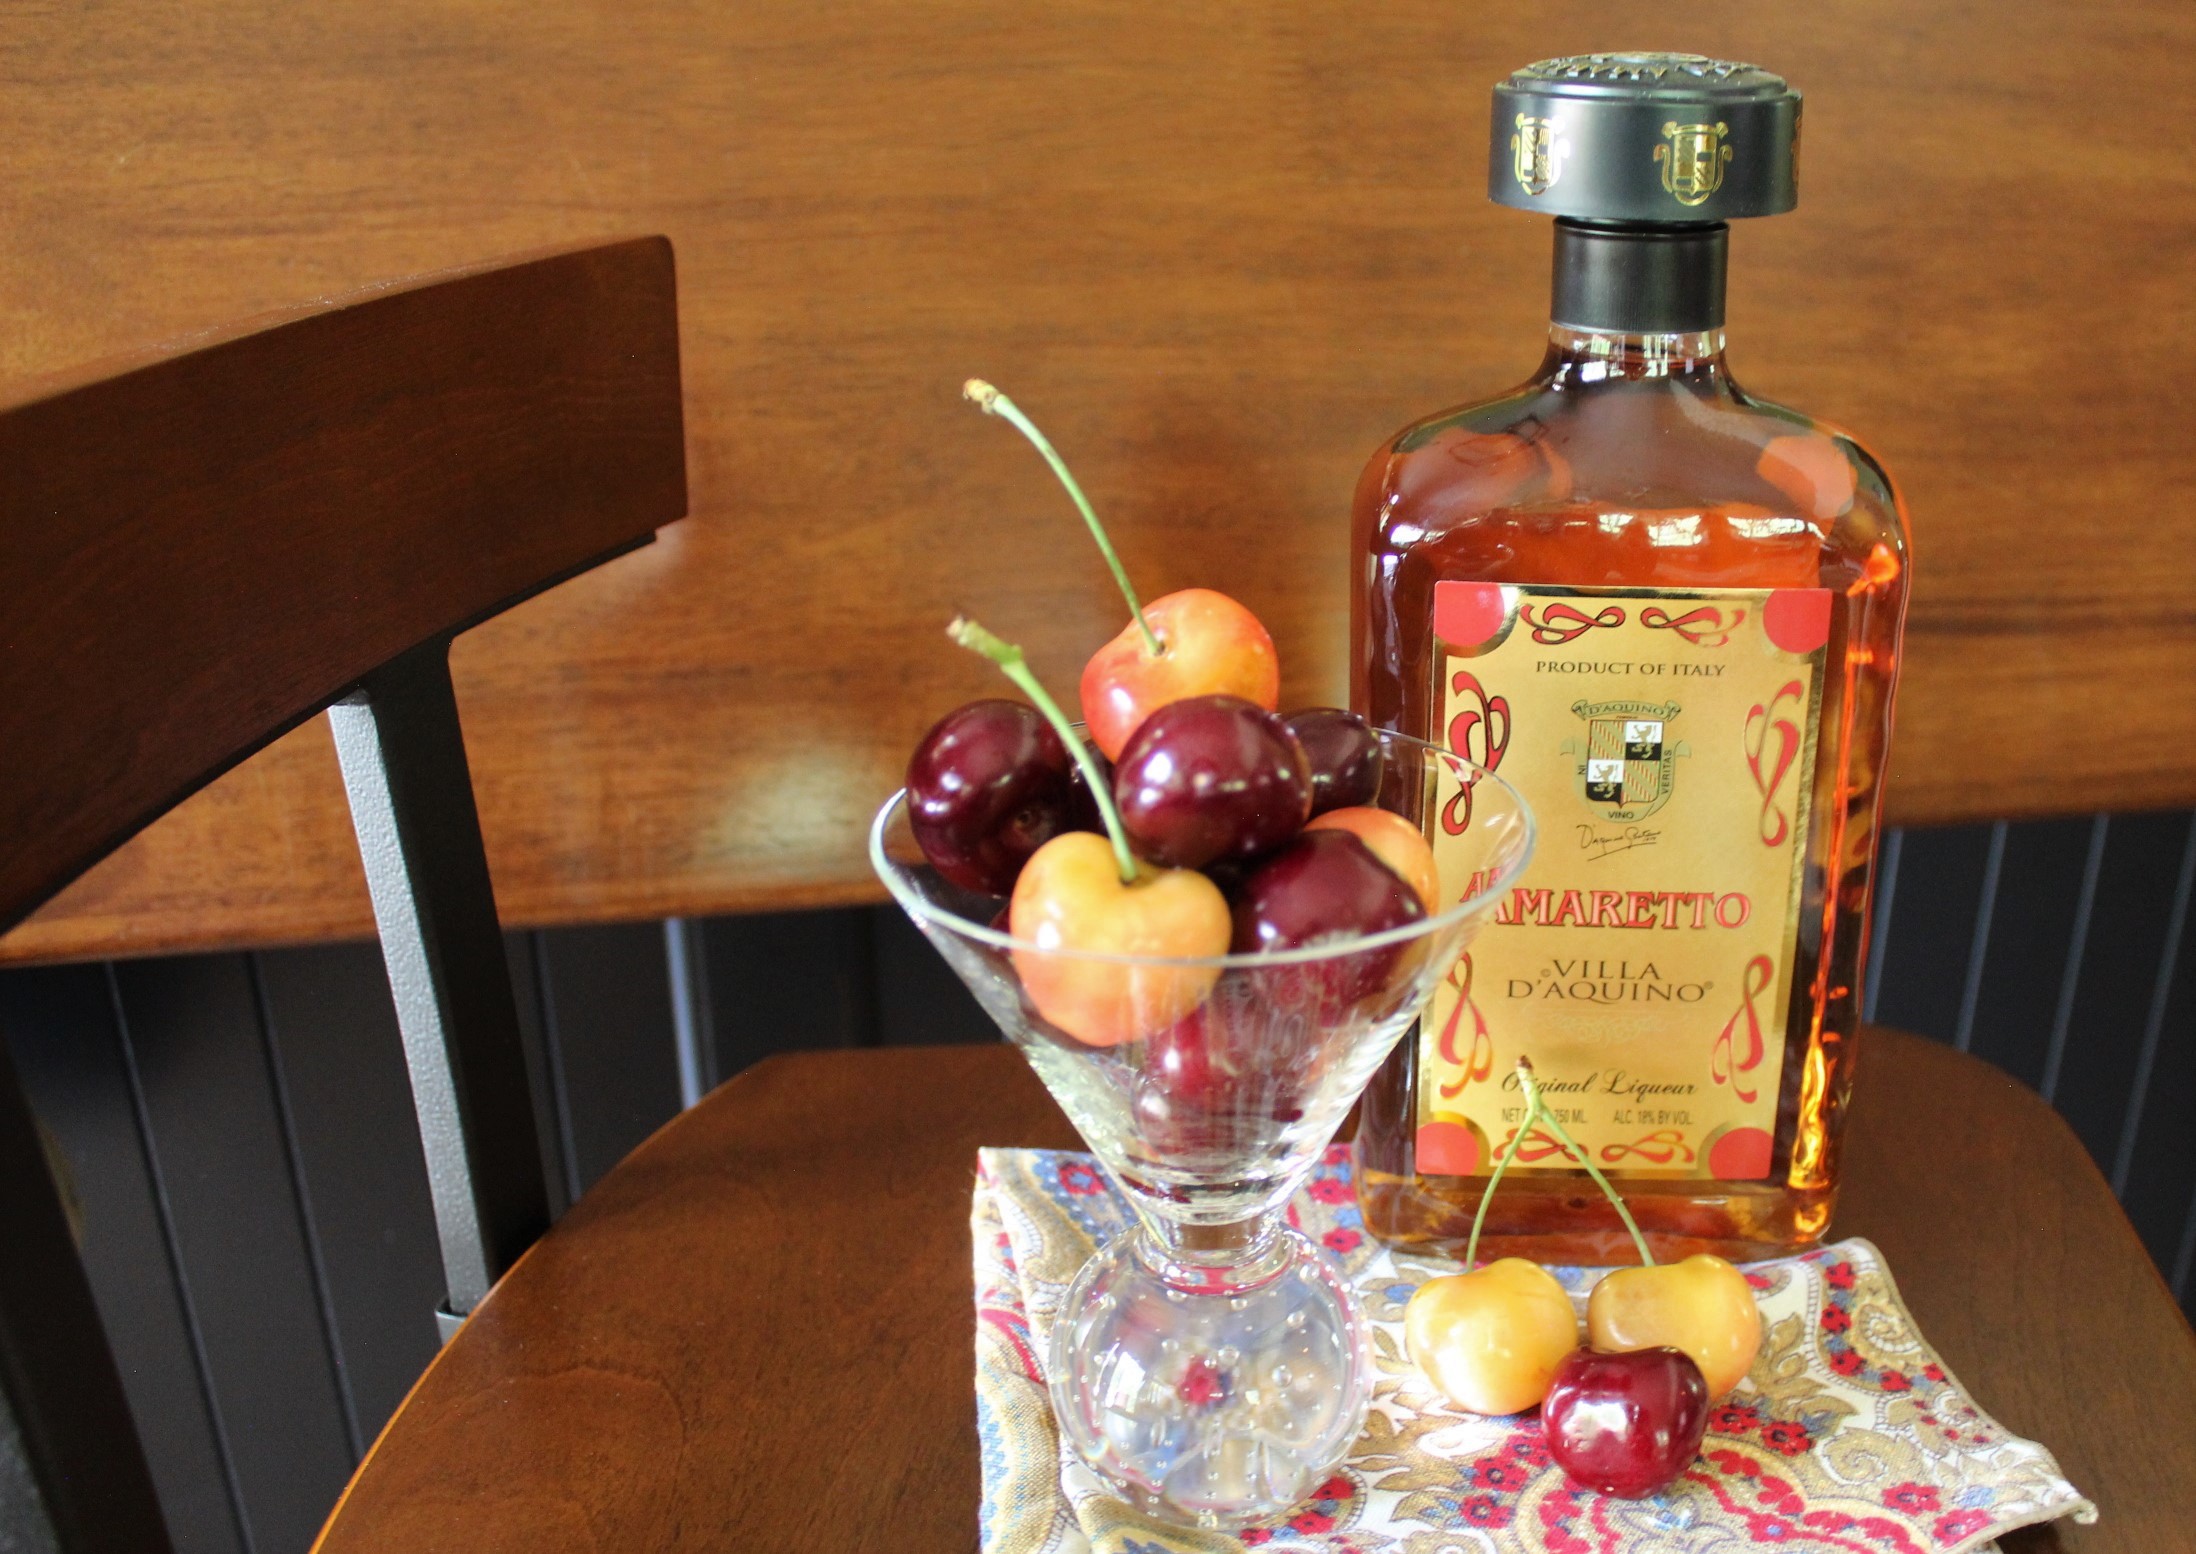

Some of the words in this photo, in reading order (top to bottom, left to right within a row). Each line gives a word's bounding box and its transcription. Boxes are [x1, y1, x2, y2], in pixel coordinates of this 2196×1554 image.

[1536, 661, 1634, 674] PRODUCT
[1640, 663, 1666, 675] OF
[1673, 663, 1726, 677] ITALY
[1588, 702, 1665, 716] D'AQUINO
[1661, 749, 1673, 795] VERITAS
[1607, 810, 1635, 820] VINO
[1459, 867, 1751, 930] AMARETTO
[1602, 1067, 1698, 1104] Liqueur
[1501, 1107, 1521, 1124] NET
[1657, 1109, 1671, 1125] BY
